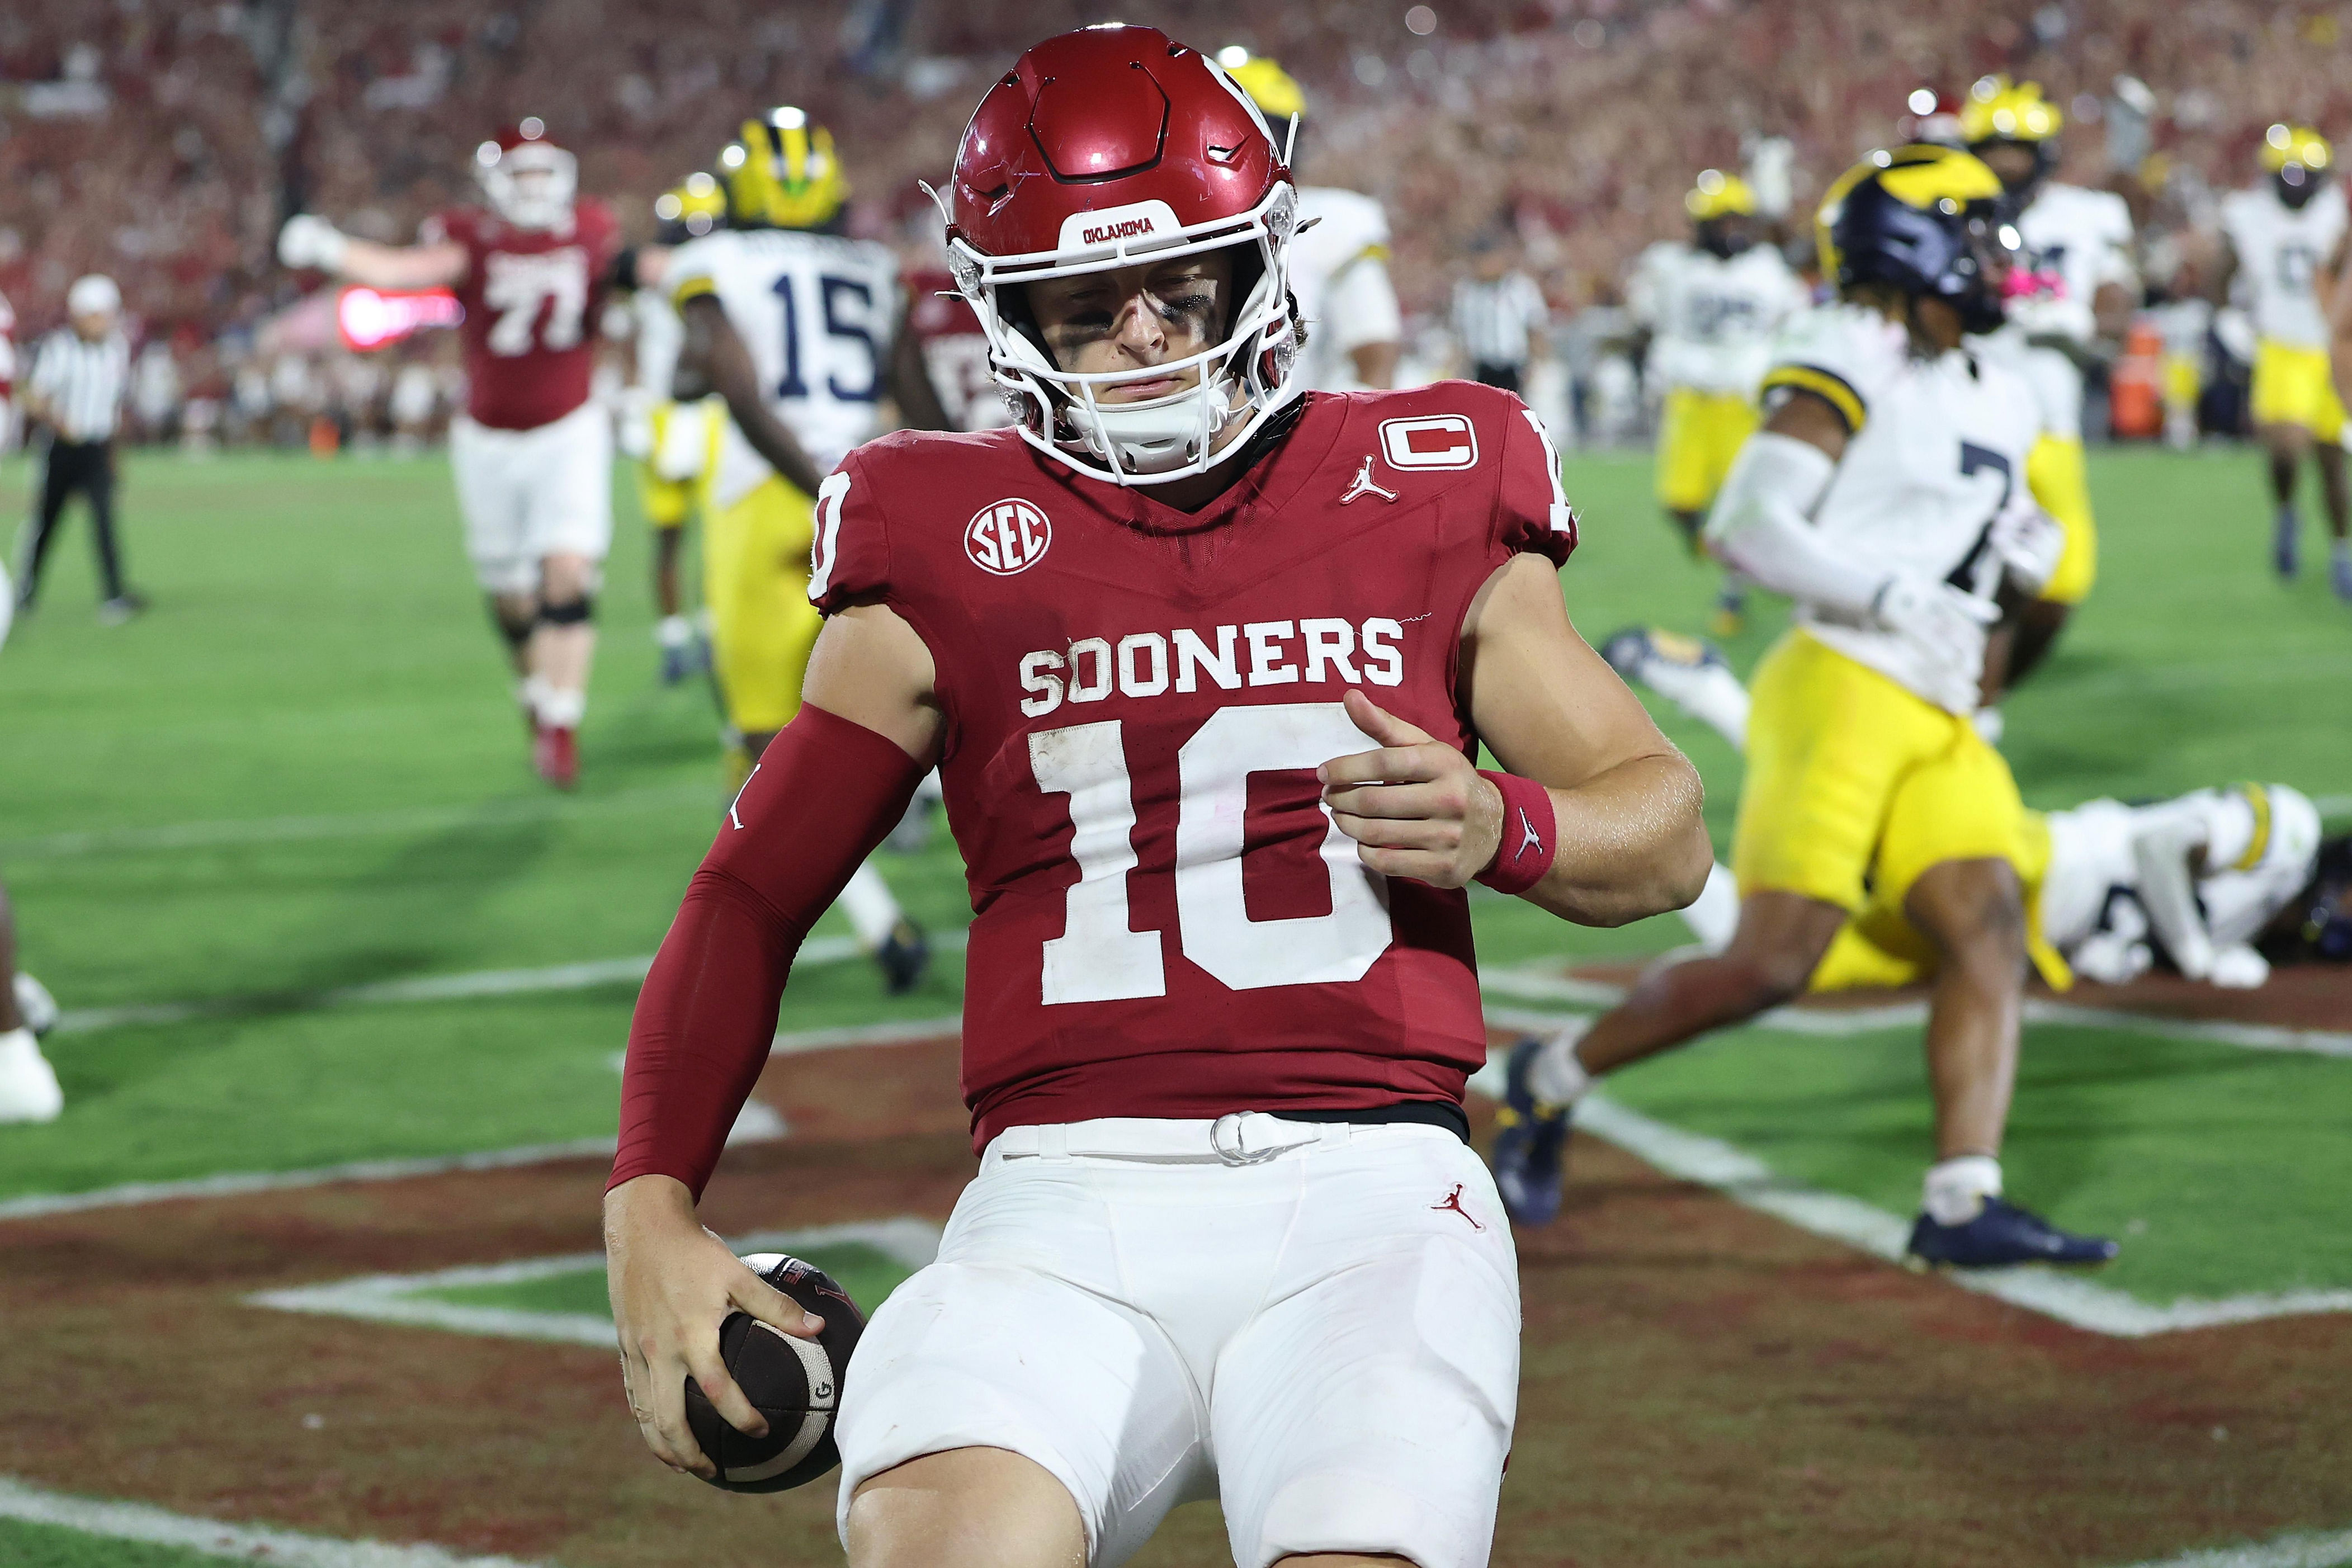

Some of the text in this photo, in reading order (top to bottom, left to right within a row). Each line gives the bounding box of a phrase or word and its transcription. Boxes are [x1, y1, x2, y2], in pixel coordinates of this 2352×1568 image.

[1083, 218, 1154, 244] OKLAHOMA
[771, 273, 880, 402] 15
[1386, 418, 1470, 465] C
[972, 504, 1043, 570] SEC
[1019, 616, 1404, 719] SOONERS
[1028, 702, 1394, 1005] 10
